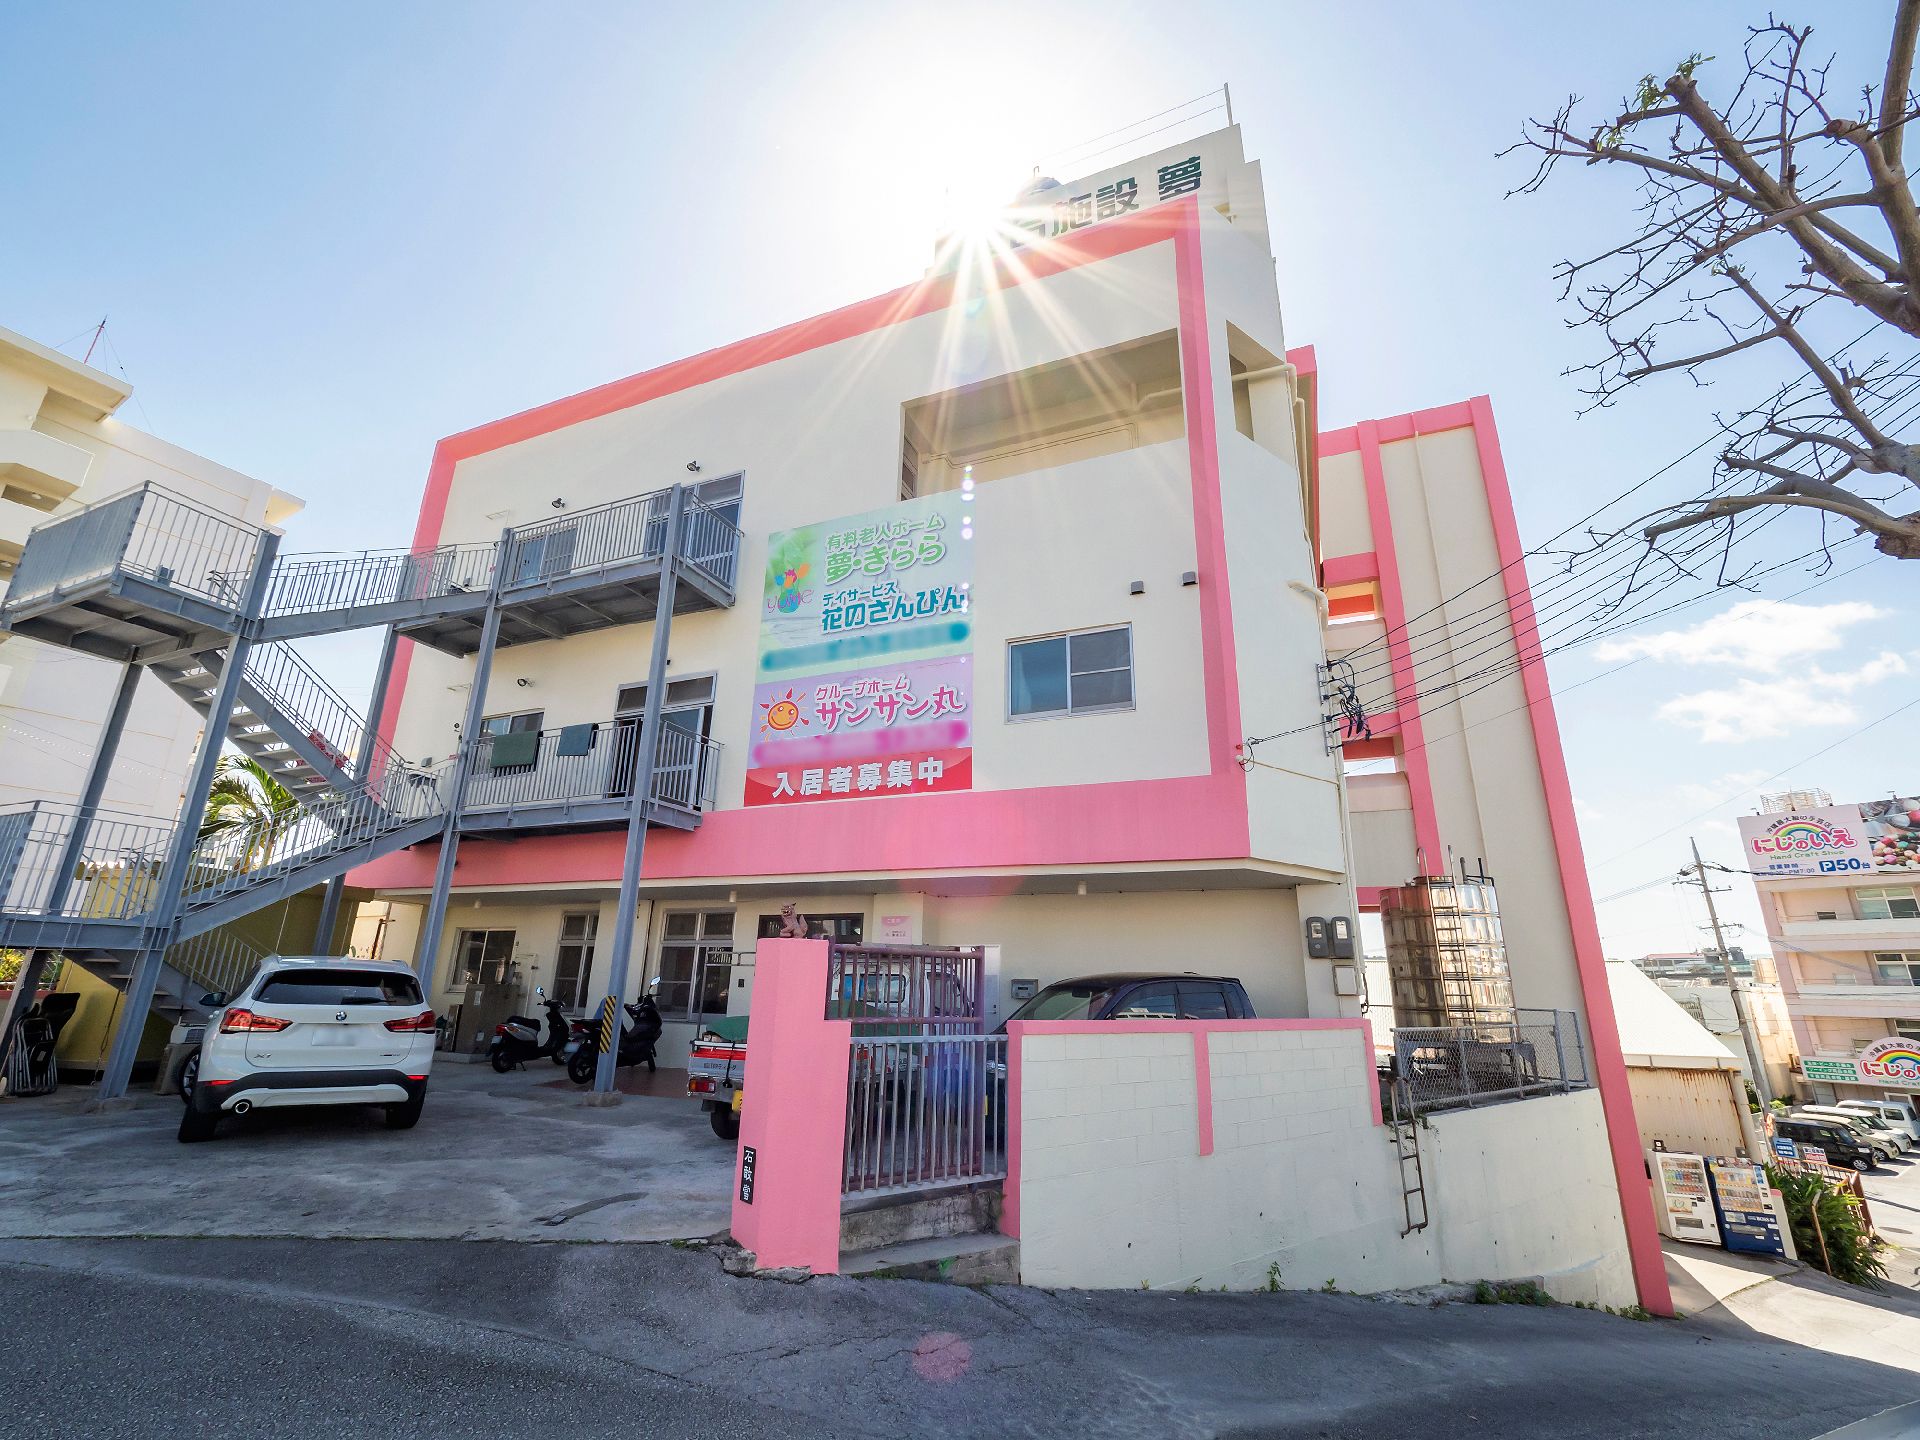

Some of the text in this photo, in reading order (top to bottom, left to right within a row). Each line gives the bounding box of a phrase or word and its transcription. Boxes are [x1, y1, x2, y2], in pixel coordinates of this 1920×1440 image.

[1157, 155, 1202, 202] 夢
[826, 513, 945, 549] 有料老人ホーム
[826, 535, 944, 583] 夢・きらら
[822, 582, 897, 606] デイサービス
[822, 586, 965, 631] 花のさんぴん
[816, 675, 910, 700] グループホーム
[815, 687, 966, 731] サンサン丸
[772, 757, 943, 798] 入居者募集中
[1752, 829, 1857, 853] にじのいえ
